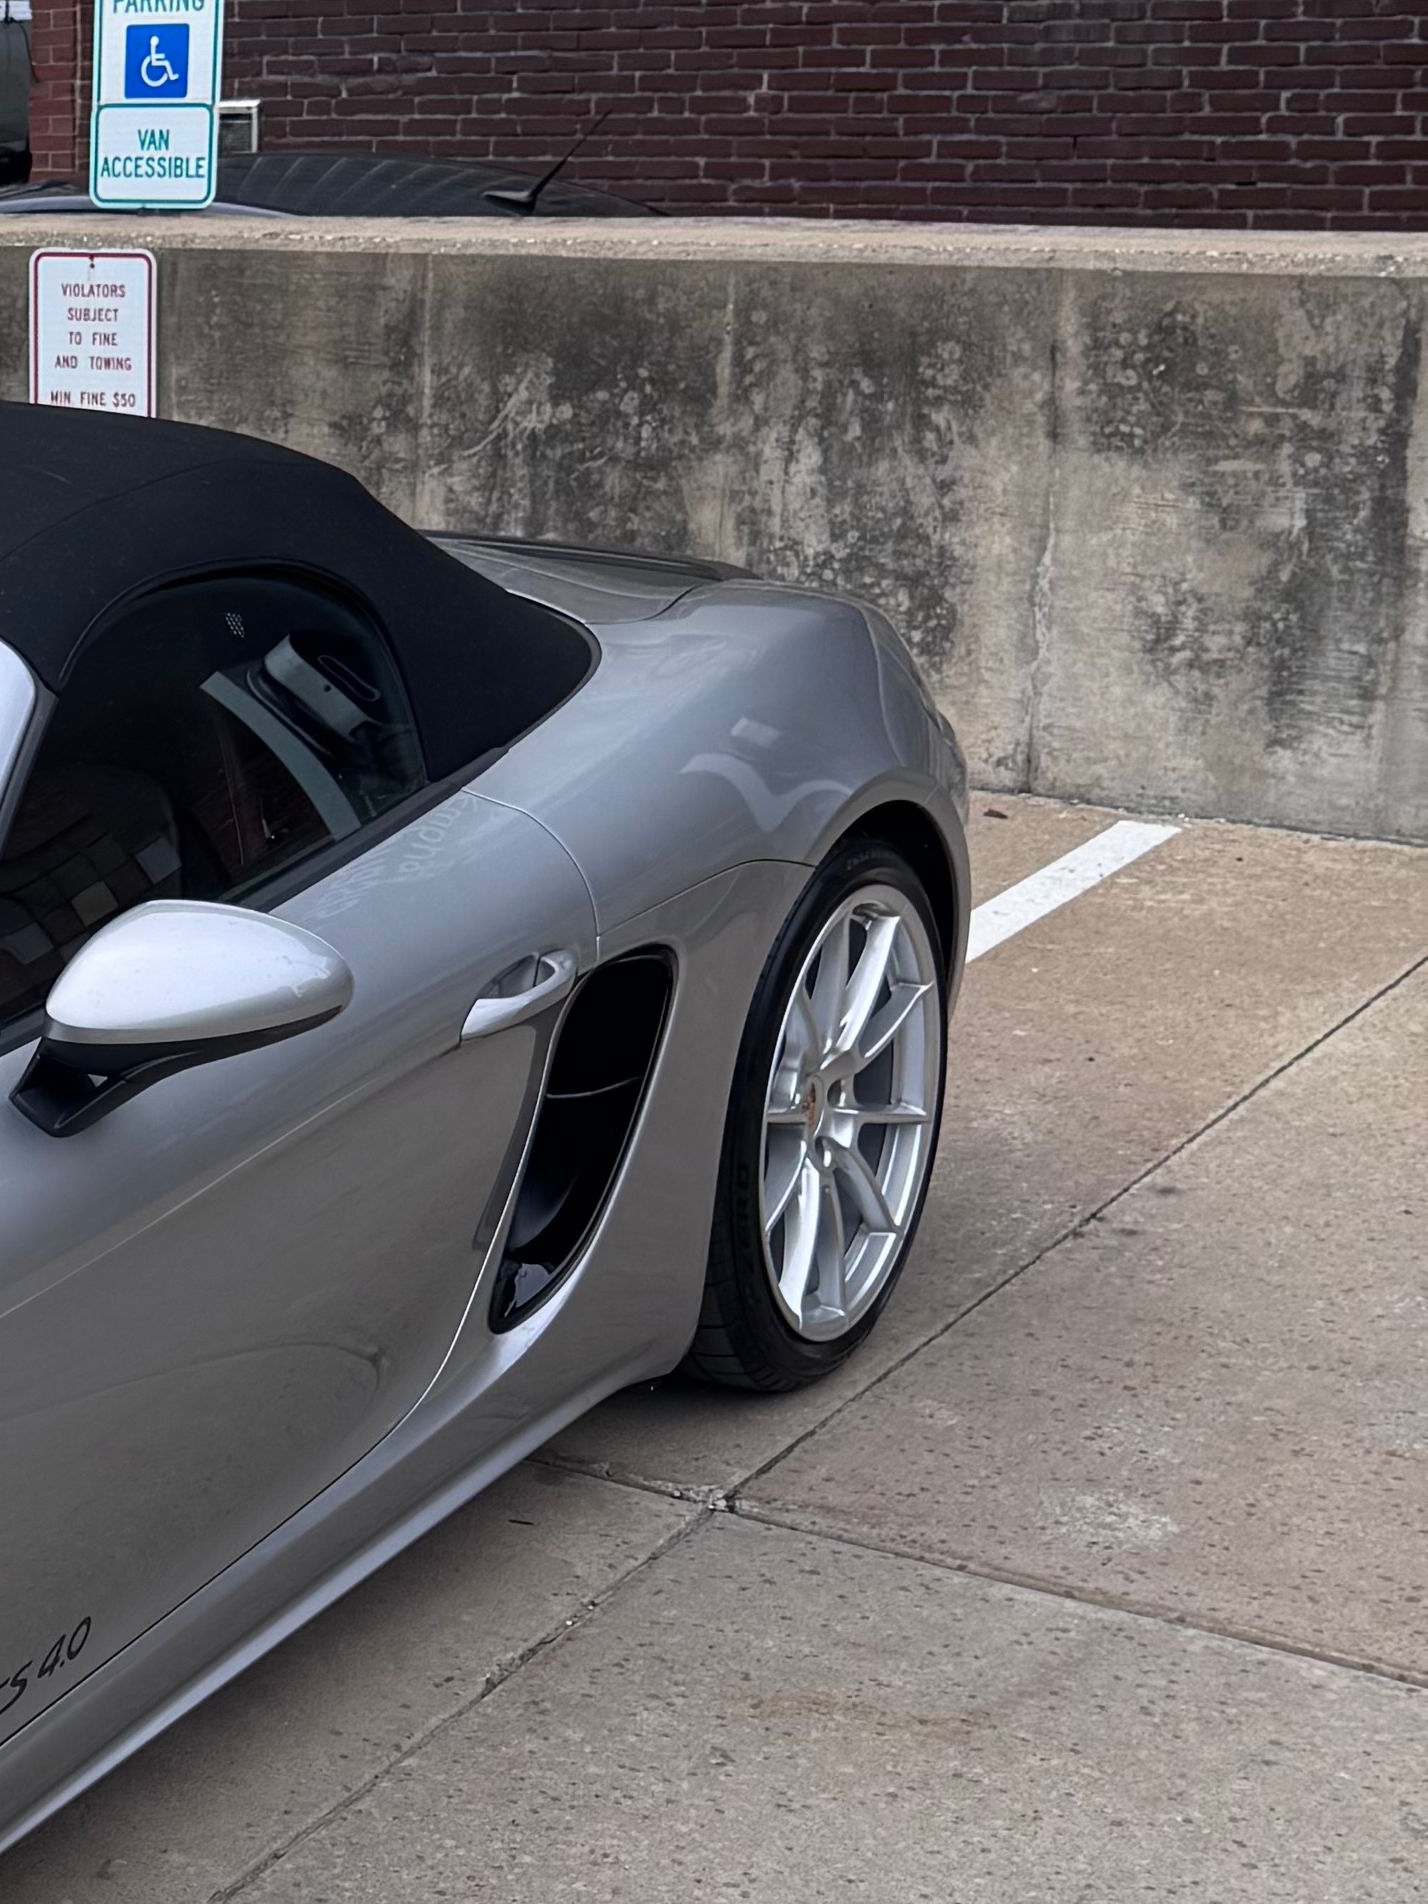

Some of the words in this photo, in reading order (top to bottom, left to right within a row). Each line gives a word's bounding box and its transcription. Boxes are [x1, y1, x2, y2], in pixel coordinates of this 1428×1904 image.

[137, 128, 170, 151] VAN
[101, 156, 207, 179] ACCESSIBLE
[61, 283, 126, 298] VIOLATORS
[67, 307, 119, 322] SUBJECT
[68, 331, 83, 346] TO
[92, 332, 118, 346] FINE
[55, 355, 78, 369] AND
[89, 356, 133, 371] TOWING
[80, 391, 106, 406] FINE
[112, 391, 136, 408] $50
[37, 1616, 92, 1679] 4.0
